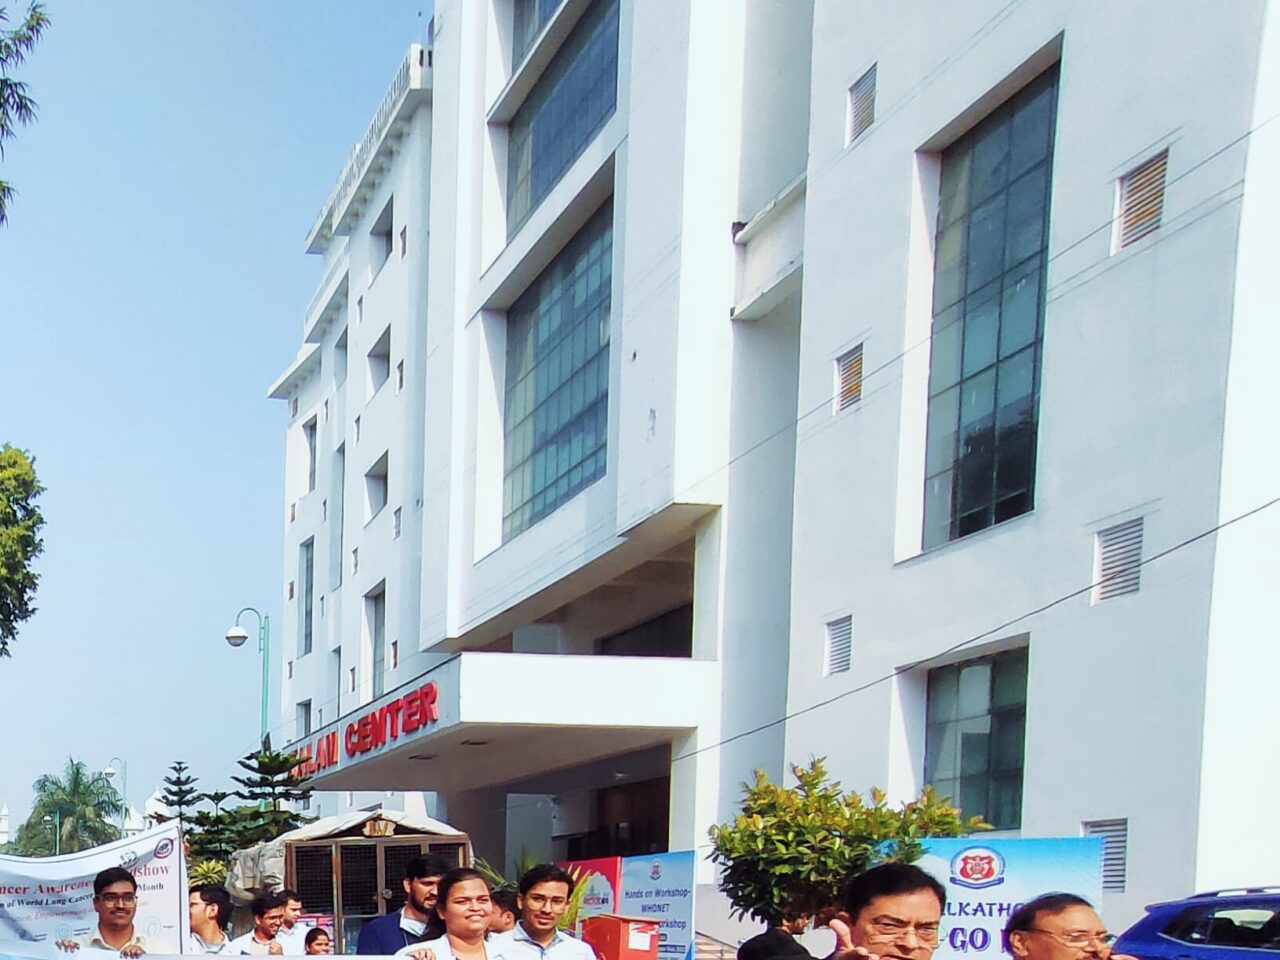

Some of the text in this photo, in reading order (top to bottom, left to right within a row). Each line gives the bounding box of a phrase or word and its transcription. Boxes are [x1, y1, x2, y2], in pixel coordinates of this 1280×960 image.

[344, 682, 438, 757] CENTER
[34, 879, 94, 895] Awarene
[131, 864, 171, 877] dshow
[7, 899, 16, 908] of
[17, 898, 43, 906] World
[45, 897, 67, 906] Lung
[68, 893, 93, 904] Cancer
[137, 883, 164, 891] Month
[625, 889, 643, 898] Hands
[641, 903, 670, 912] WHONET
[658, 919, 687, 930] orkshop
[949, 927, 990, 953] GO
